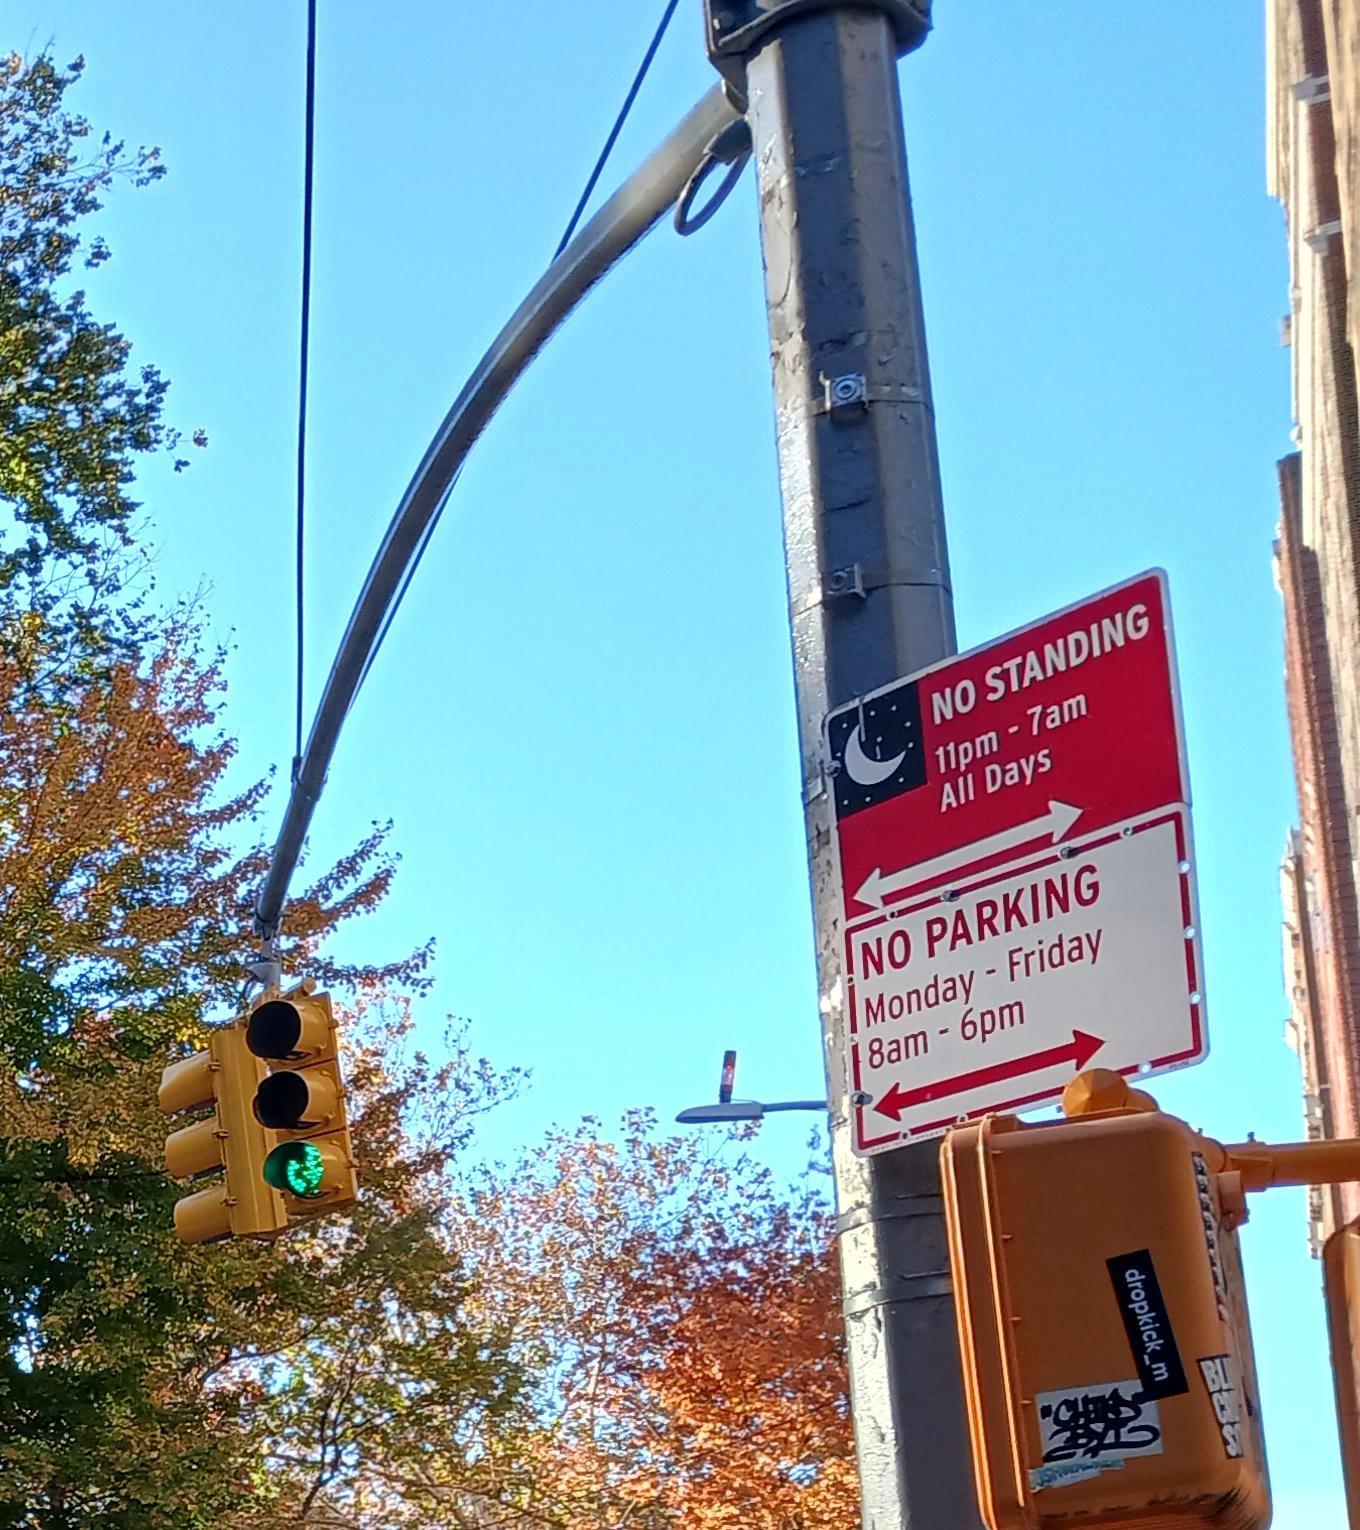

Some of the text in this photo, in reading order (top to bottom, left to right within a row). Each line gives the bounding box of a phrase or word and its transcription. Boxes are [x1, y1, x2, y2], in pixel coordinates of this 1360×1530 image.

[931, 603, 1150, 726] NO STANDING
[934, 730, 999, 775] 11pm
[1026, 693, 1088, 736] 7am
[940, 748, 1052, 813] All Days
[861, 864, 1101, 981] NO PARKING
[864, 970, 975, 1028] Monday
[1008, 928, 1103, 983] Friday
[868, 1029, 929, 1070] 8am
[960, 1000, 1025, 1044] 6pm
[1124, 1267, 1169, 1383] dropkick_m
